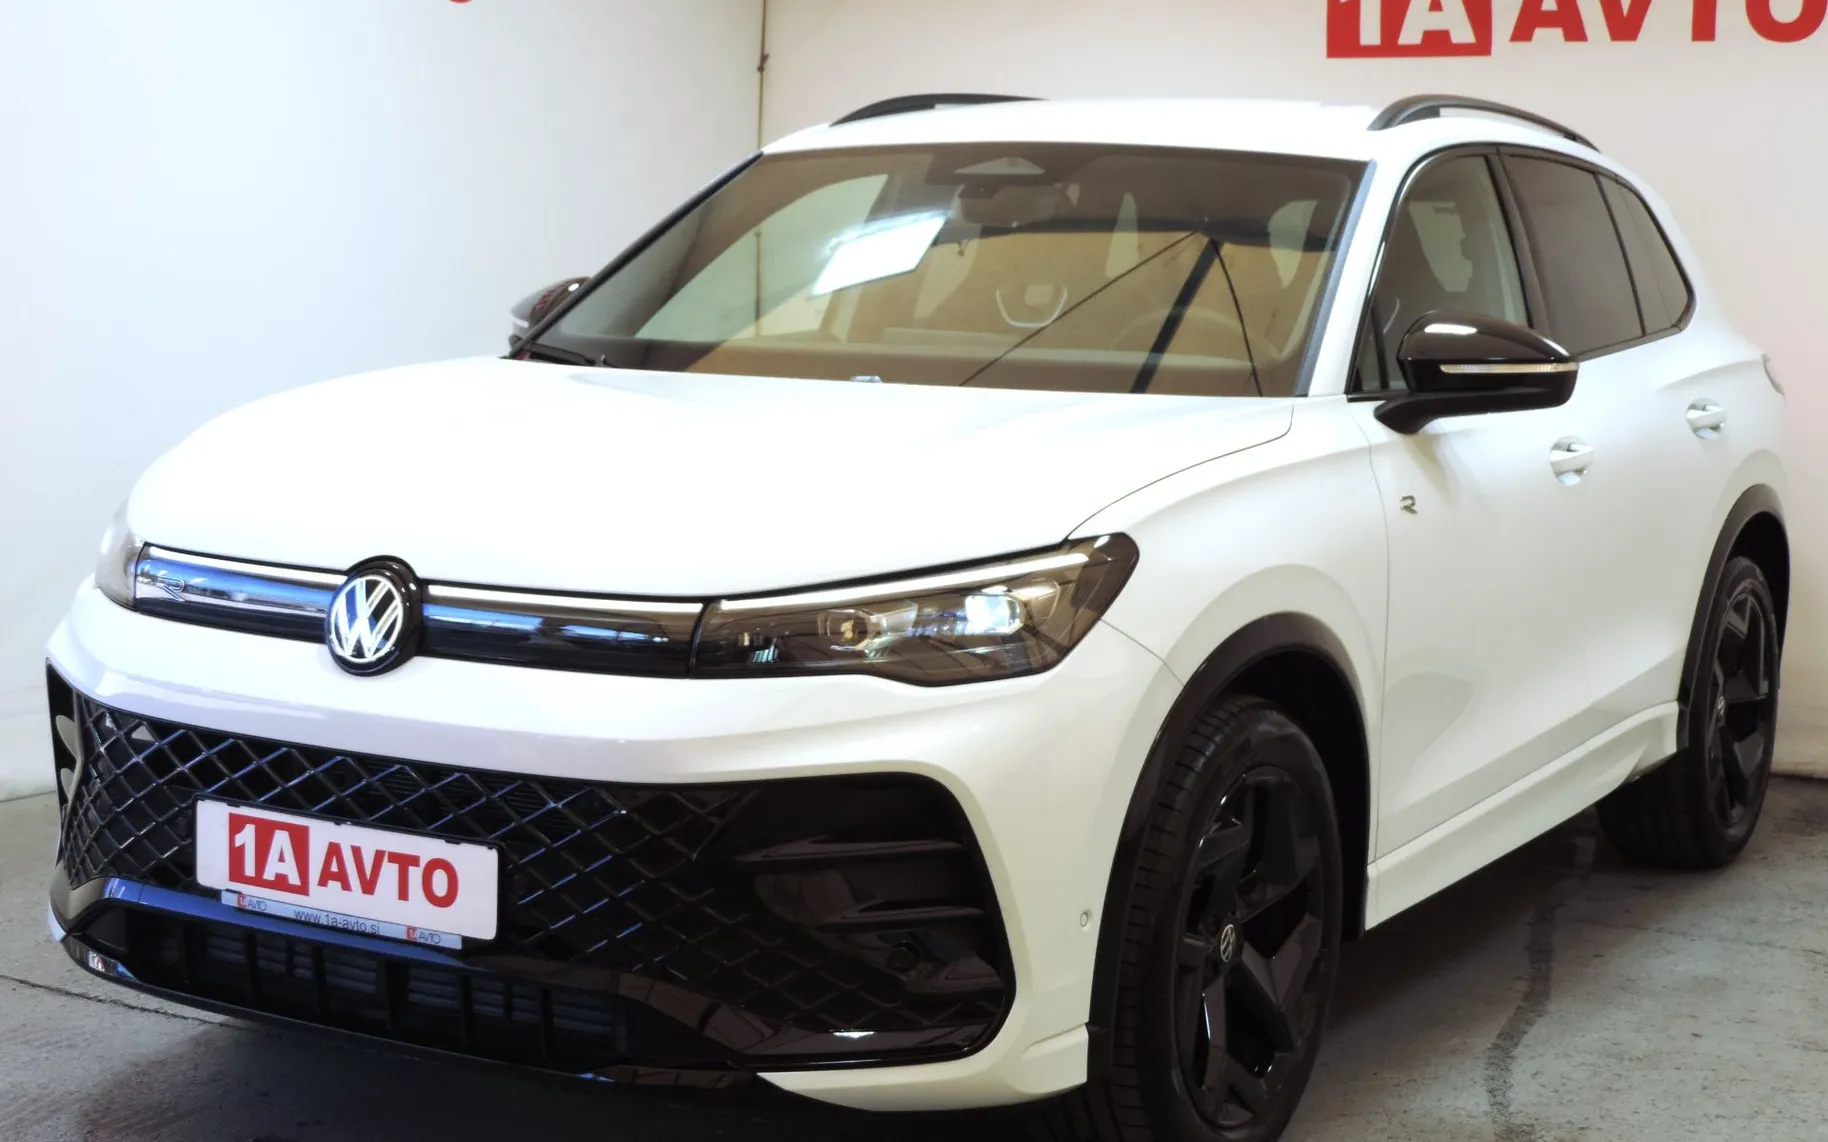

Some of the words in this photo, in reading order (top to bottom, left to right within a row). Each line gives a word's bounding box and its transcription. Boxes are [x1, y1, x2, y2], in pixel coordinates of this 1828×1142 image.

[234, 823, 302, 886] 1A
[317, 841, 459, 908] AVTO
[294, 909, 381, 935] www.1a-avto.si
